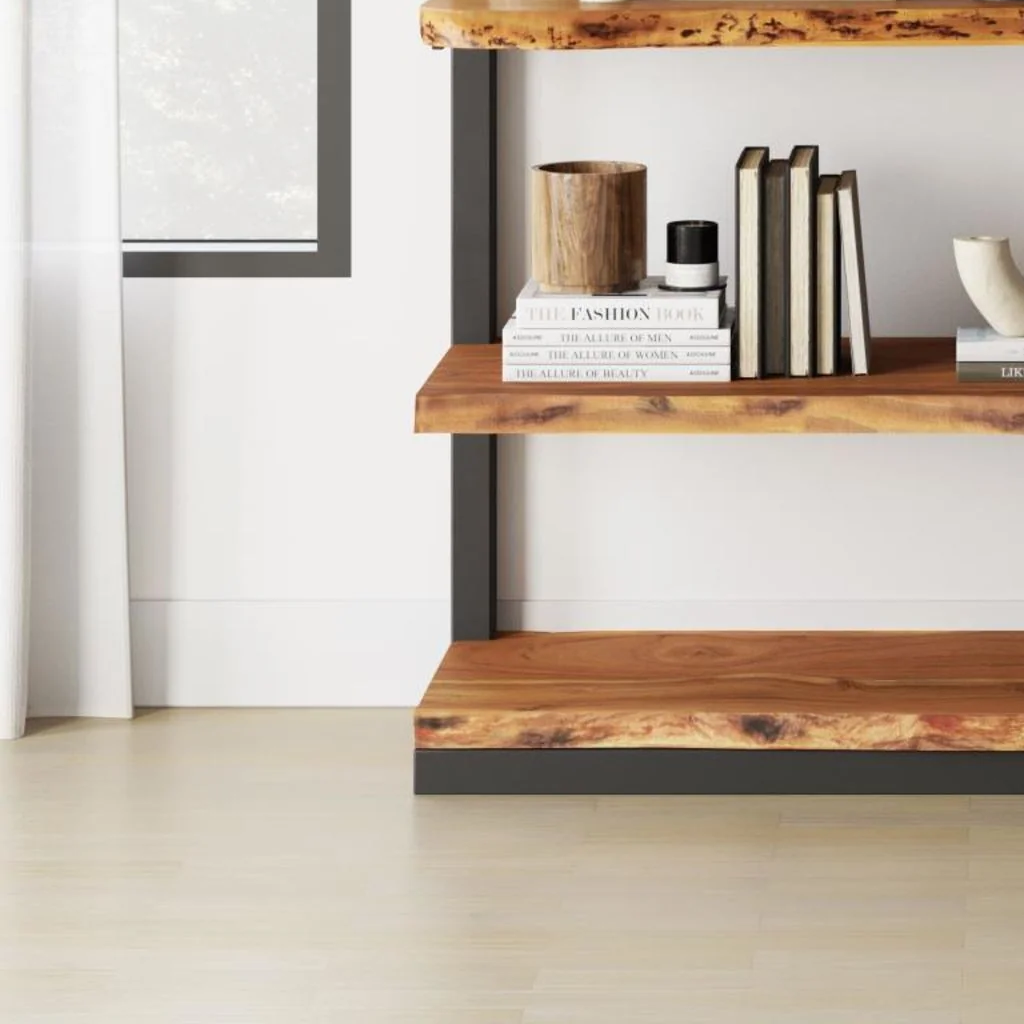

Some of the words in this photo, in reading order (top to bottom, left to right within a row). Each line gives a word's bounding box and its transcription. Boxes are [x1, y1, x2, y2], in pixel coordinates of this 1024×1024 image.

[570, 307, 651, 321] FASHION
[560, 333, 580, 343] THE
[582, 333, 627, 343] ALLURE
[630, 333, 645, 343] OF
[647, 333, 673, 343] MEN
[548, 350, 568, 360] THE
[570, 350, 615, 360] ALLURE
[618, 350, 633, 360] OF
[635, 350, 679, 360] WOMEN
[516, 368, 535, 378] THE
[538, 368, 581, 378] ALLURE
[585, 368, 600, 378] OF
[602, 368, 649, 378] BEAUTY
